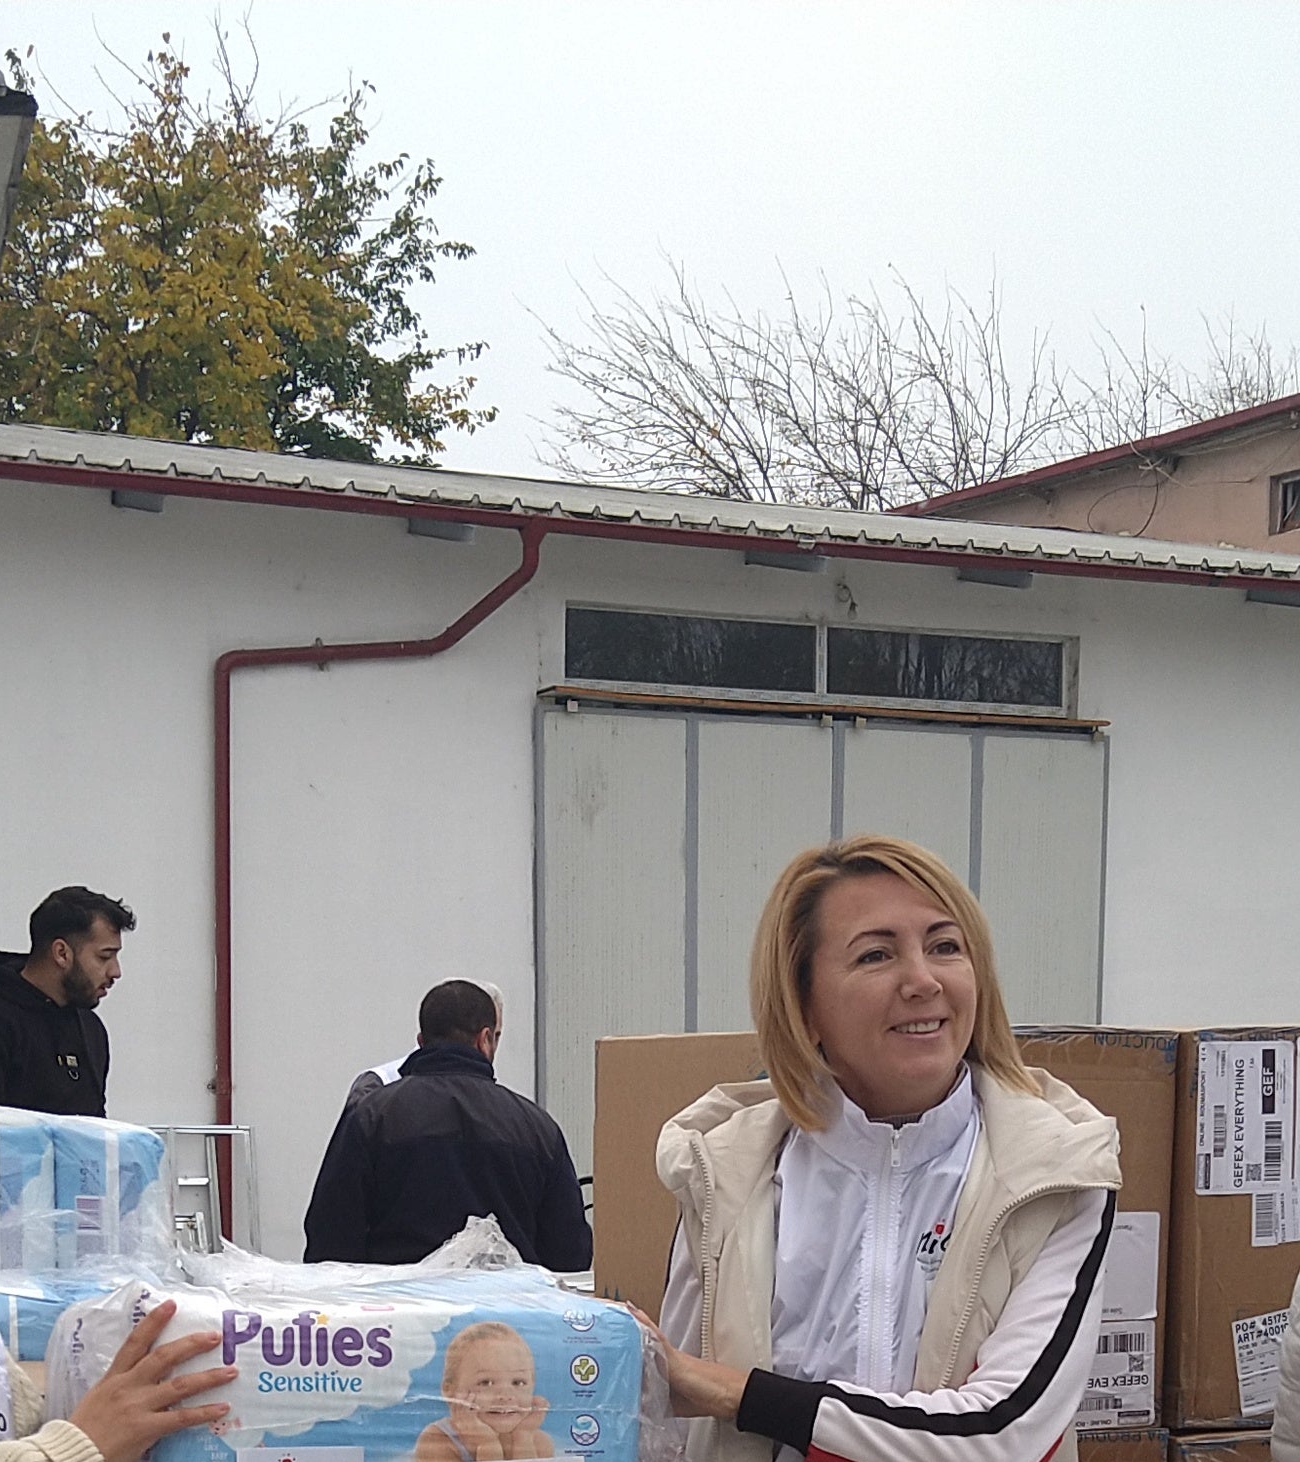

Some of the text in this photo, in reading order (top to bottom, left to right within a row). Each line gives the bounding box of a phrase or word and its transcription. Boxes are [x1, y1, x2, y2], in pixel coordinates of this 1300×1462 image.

[1263, 1067, 1274, 1097] GEF
[1234, 1059, 1245, 1188] GEFEX EVERYTHING
[222, 1310, 393, 1368] Pufies
[258, 1370, 363, 1393] Sensitive
[1112, 1374, 1149, 1387] GEFEX
